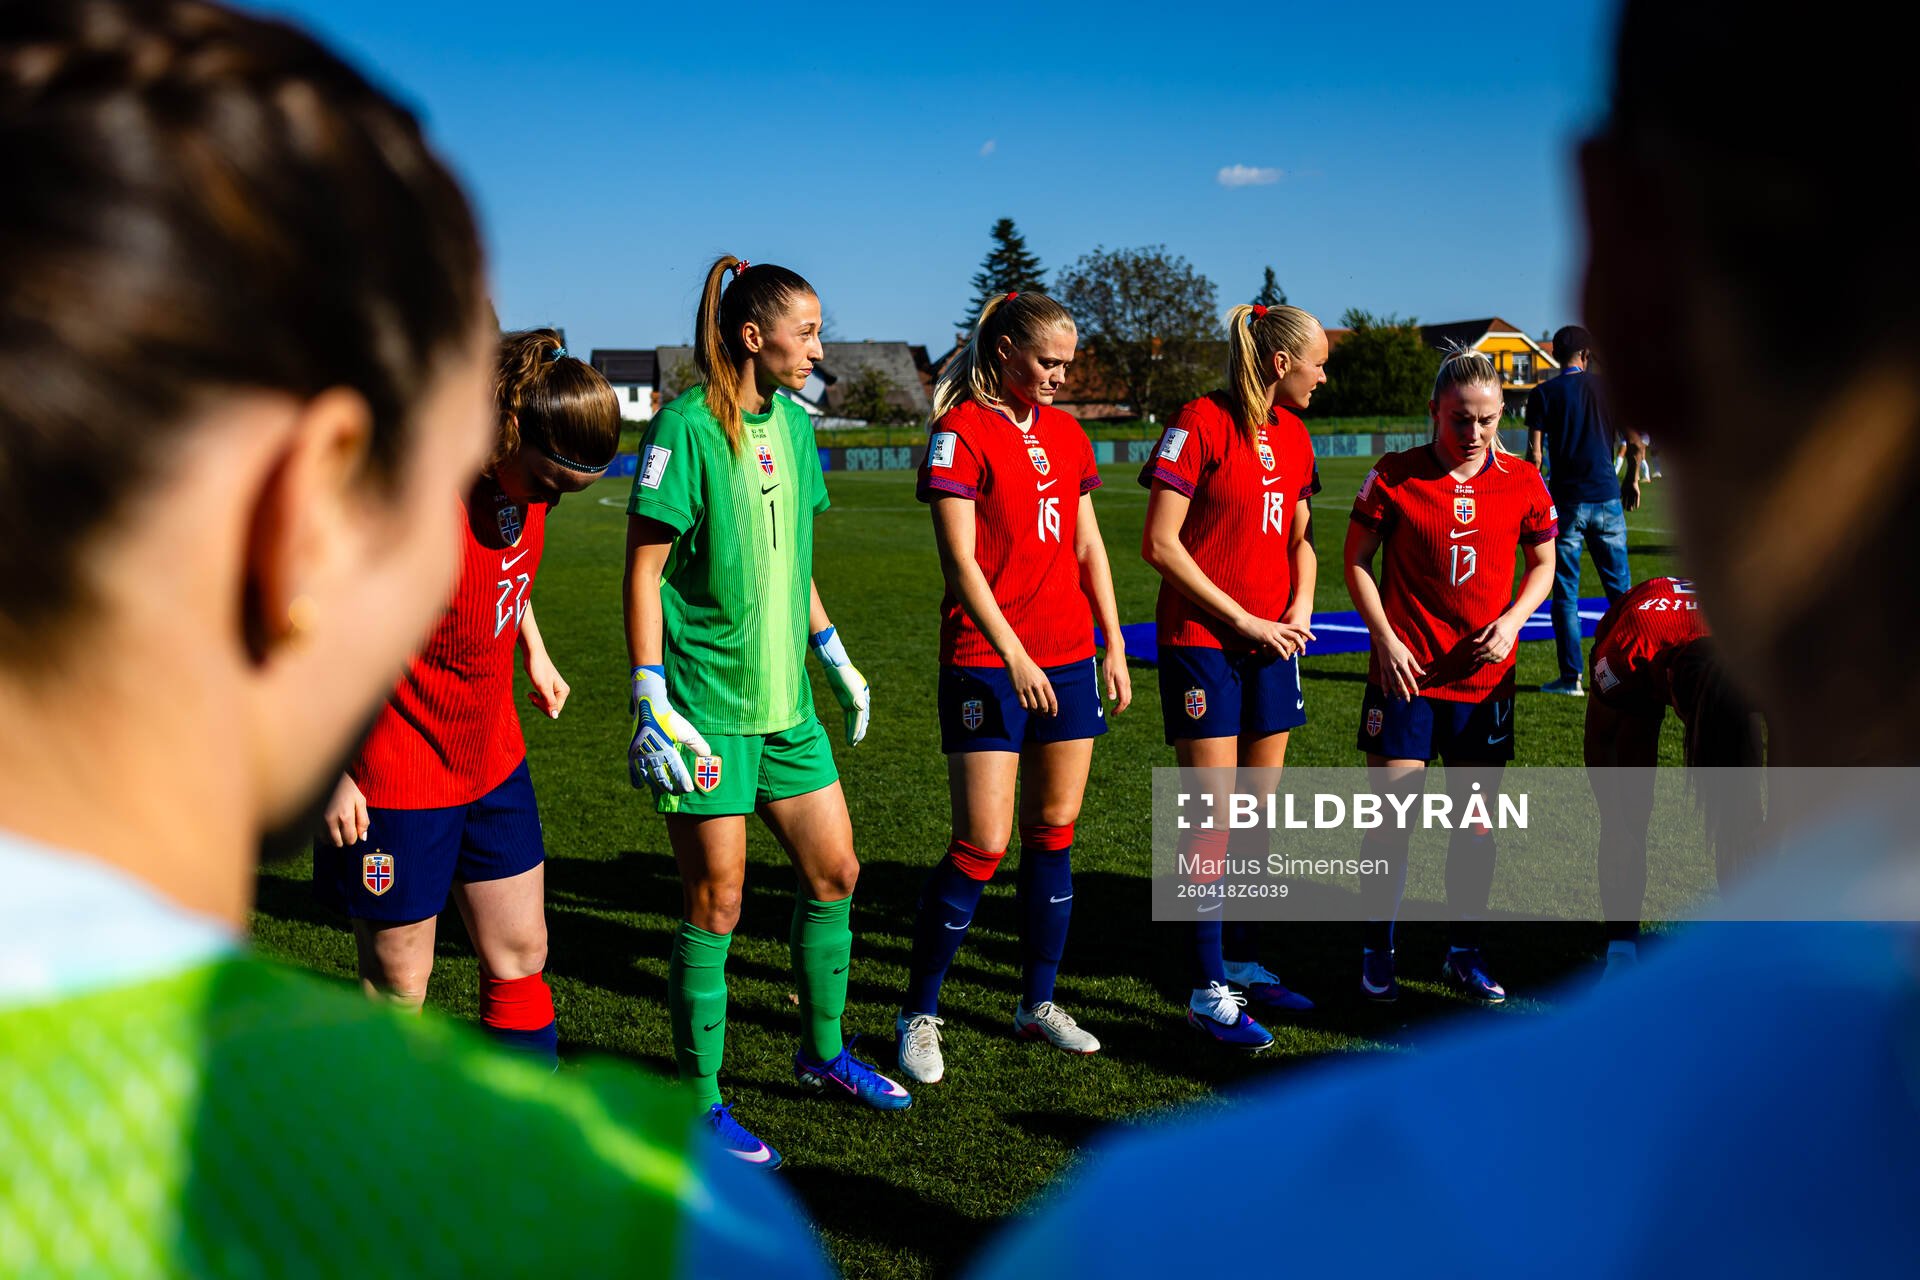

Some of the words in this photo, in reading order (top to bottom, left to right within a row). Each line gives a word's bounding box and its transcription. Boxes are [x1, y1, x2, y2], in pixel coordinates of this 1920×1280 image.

[769, 500, 777, 550] 1
[1037, 497, 1061, 543] 16
[1262, 491, 1283, 535] 18
[1449, 544, 1478, 587] 13
[494, 572, 530, 639] 22
